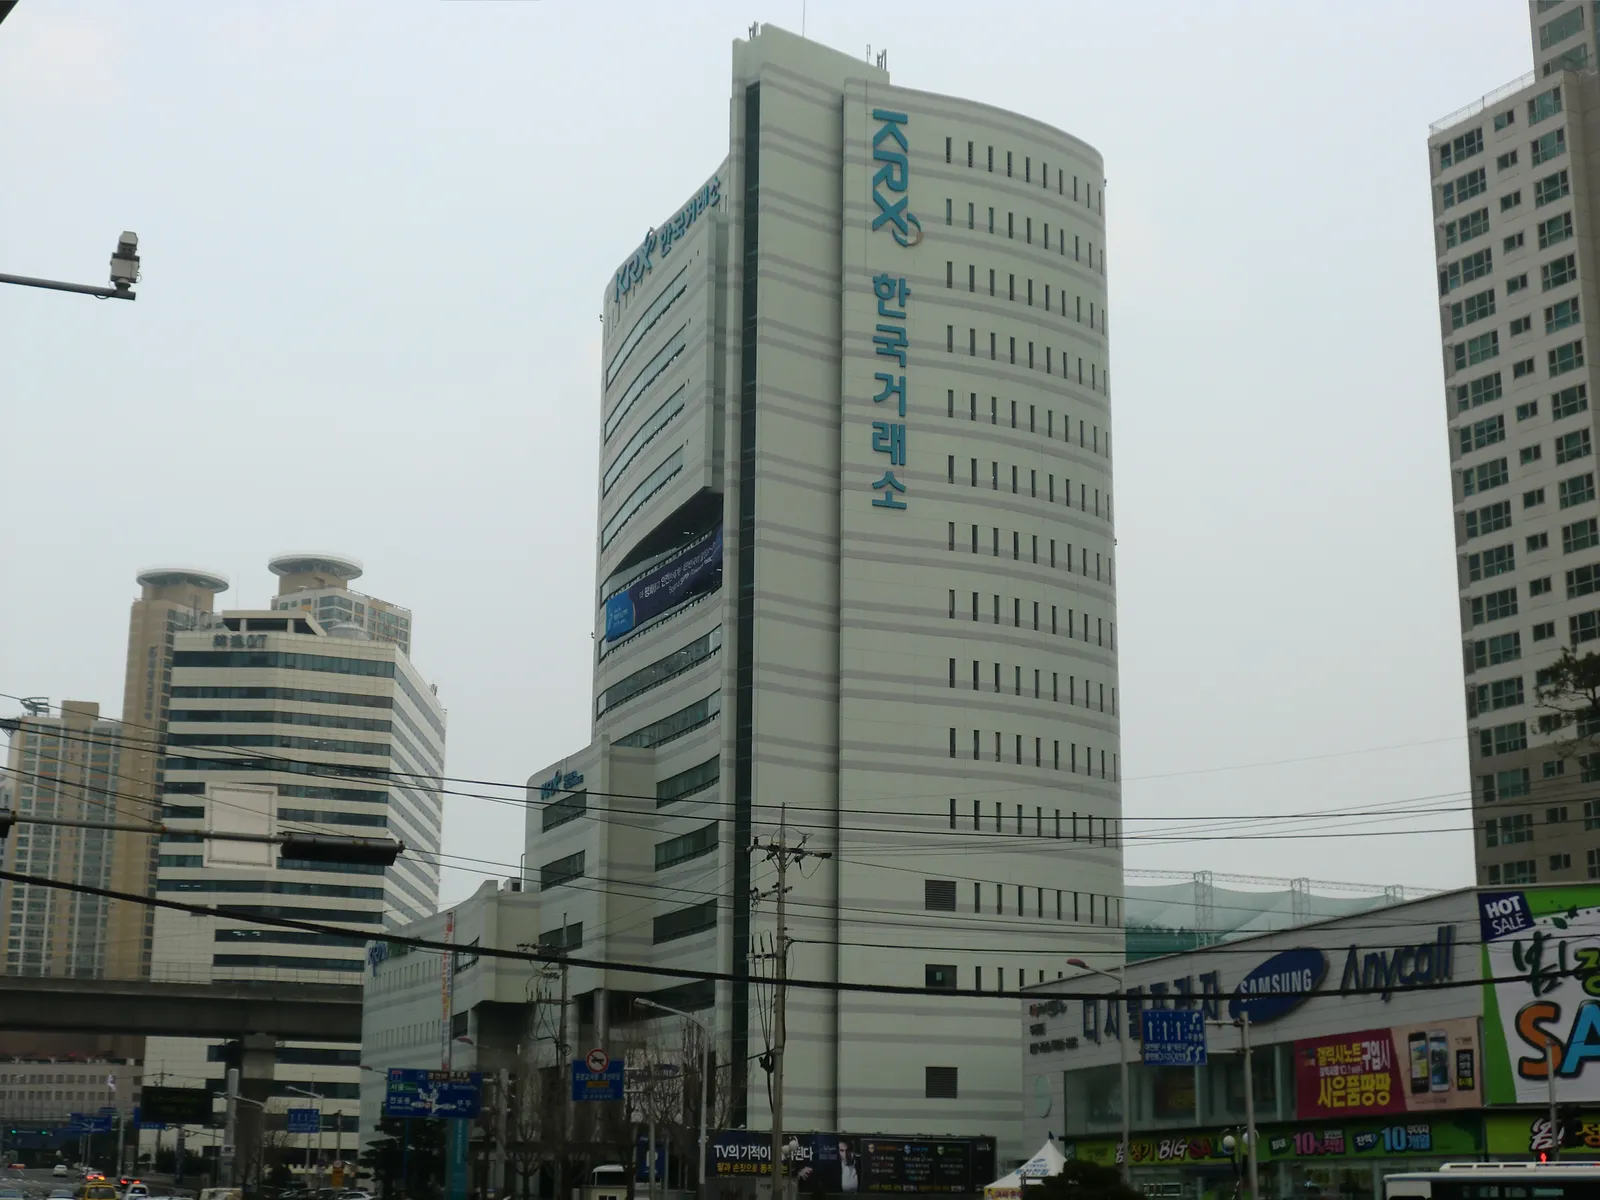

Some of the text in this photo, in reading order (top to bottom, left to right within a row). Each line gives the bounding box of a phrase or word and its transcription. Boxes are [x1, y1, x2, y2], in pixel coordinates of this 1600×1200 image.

[873, 109, 915, 246] KRX
[615, 228, 657, 303] KRX
[872, 272, 911, 509] 한국거래소
[1485, 895, 1521, 919] HOT
[1492, 912, 1527, 935] SALE
[1341, 925, 1456, 1003] Anycall
[1239, 967, 1313, 1003] SAMSUNG
[1316, 1042, 1362, 1067] 갤럭시노트
[1361, 1038, 1391, 1071] 구입시
[1316, 1072, 1392, 1108] 사은품팡팡
[714, 1145, 739, 1160] TV의
[741, 1144, 772, 1161] 기적이
[1132, 1143, 1155, 1162] 정기
[1158, 1137, 1189, 1161] BIG
[1381, 1126, 1407, 1152] 10
[1406, 1134, 1431, 1149] 개월
[732, 1162, 757, 1173] 손짓으로
